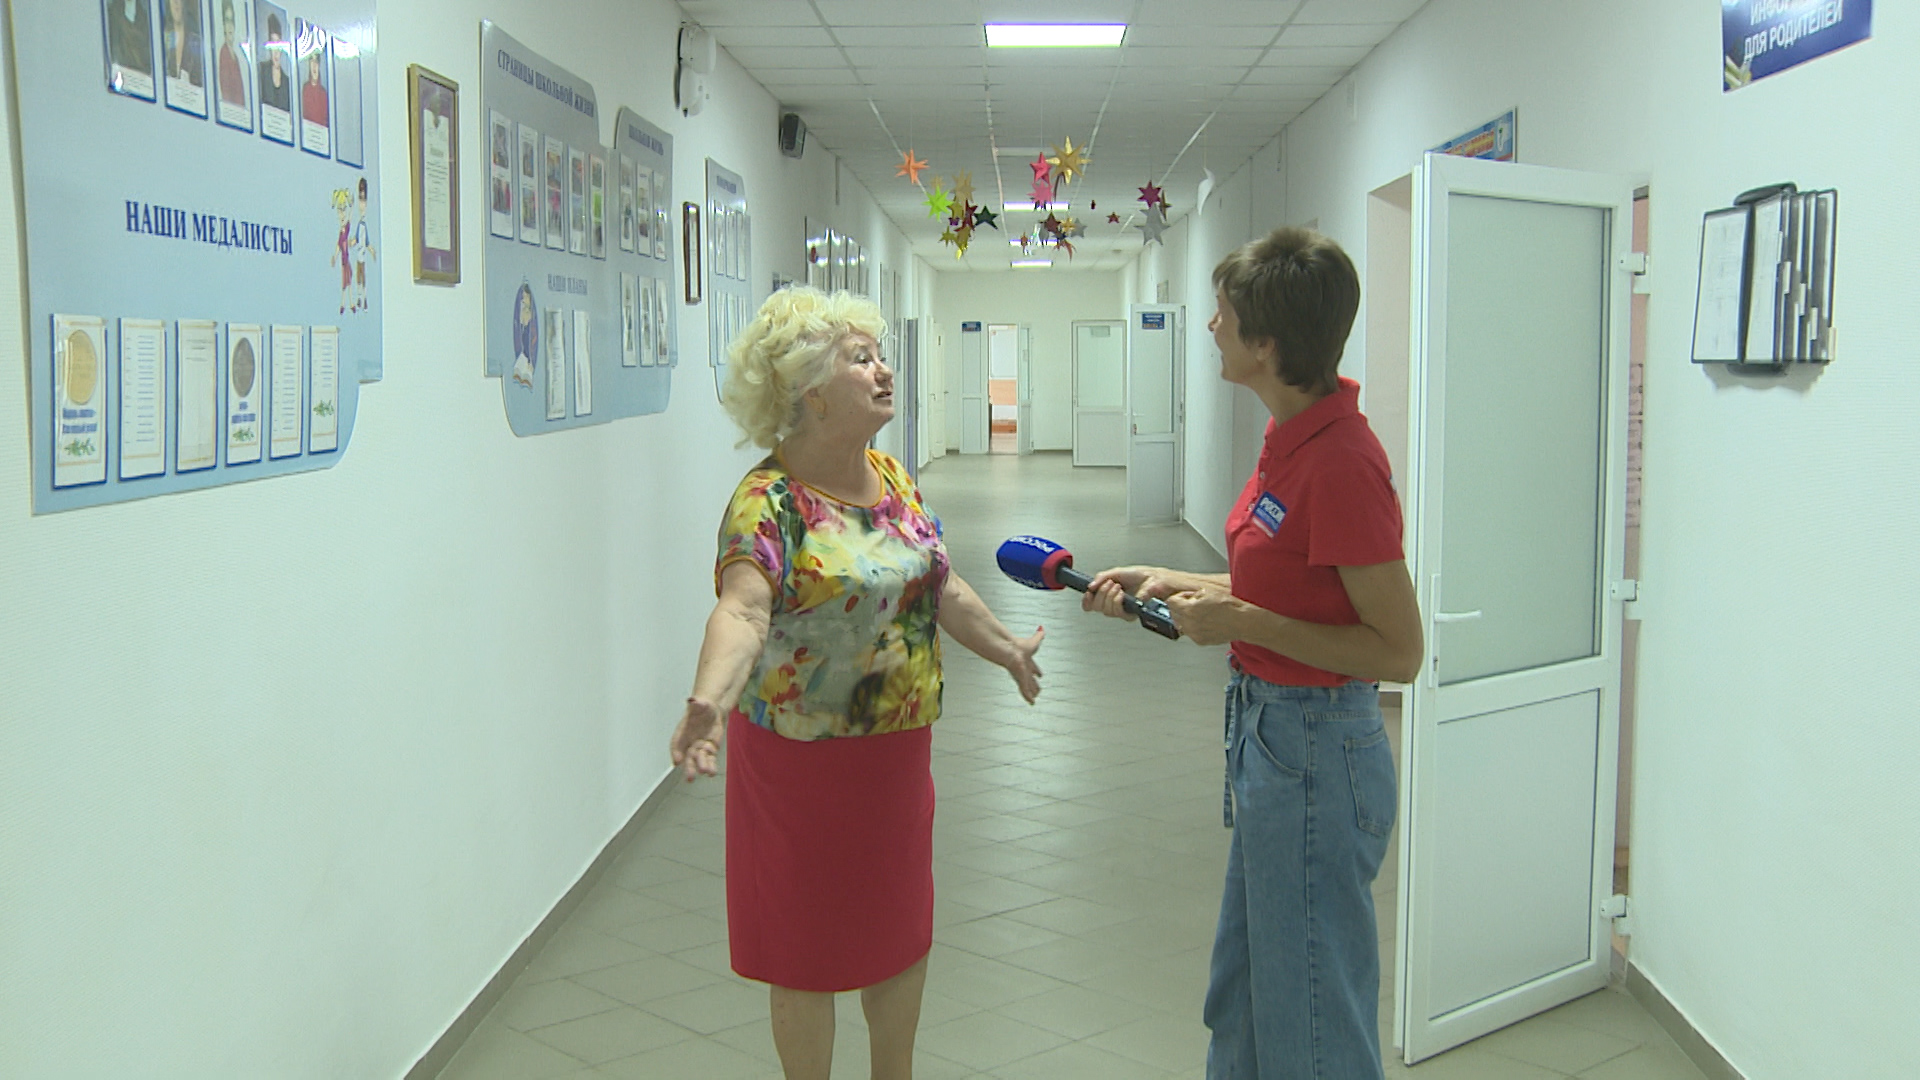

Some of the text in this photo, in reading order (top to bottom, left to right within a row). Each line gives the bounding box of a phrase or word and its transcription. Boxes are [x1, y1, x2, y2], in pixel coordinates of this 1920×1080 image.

[1743, 0, 1844, 63] ДЛЯ РОДИТЕЛЕЙ
[497, 49, 534, 86] СТРАНИЦЫ
[535, 71, 574, 108] ШКОЛЬНОЙ
[125, 199, 293, 255] НАШИ МЕДАЛИСТЫ
